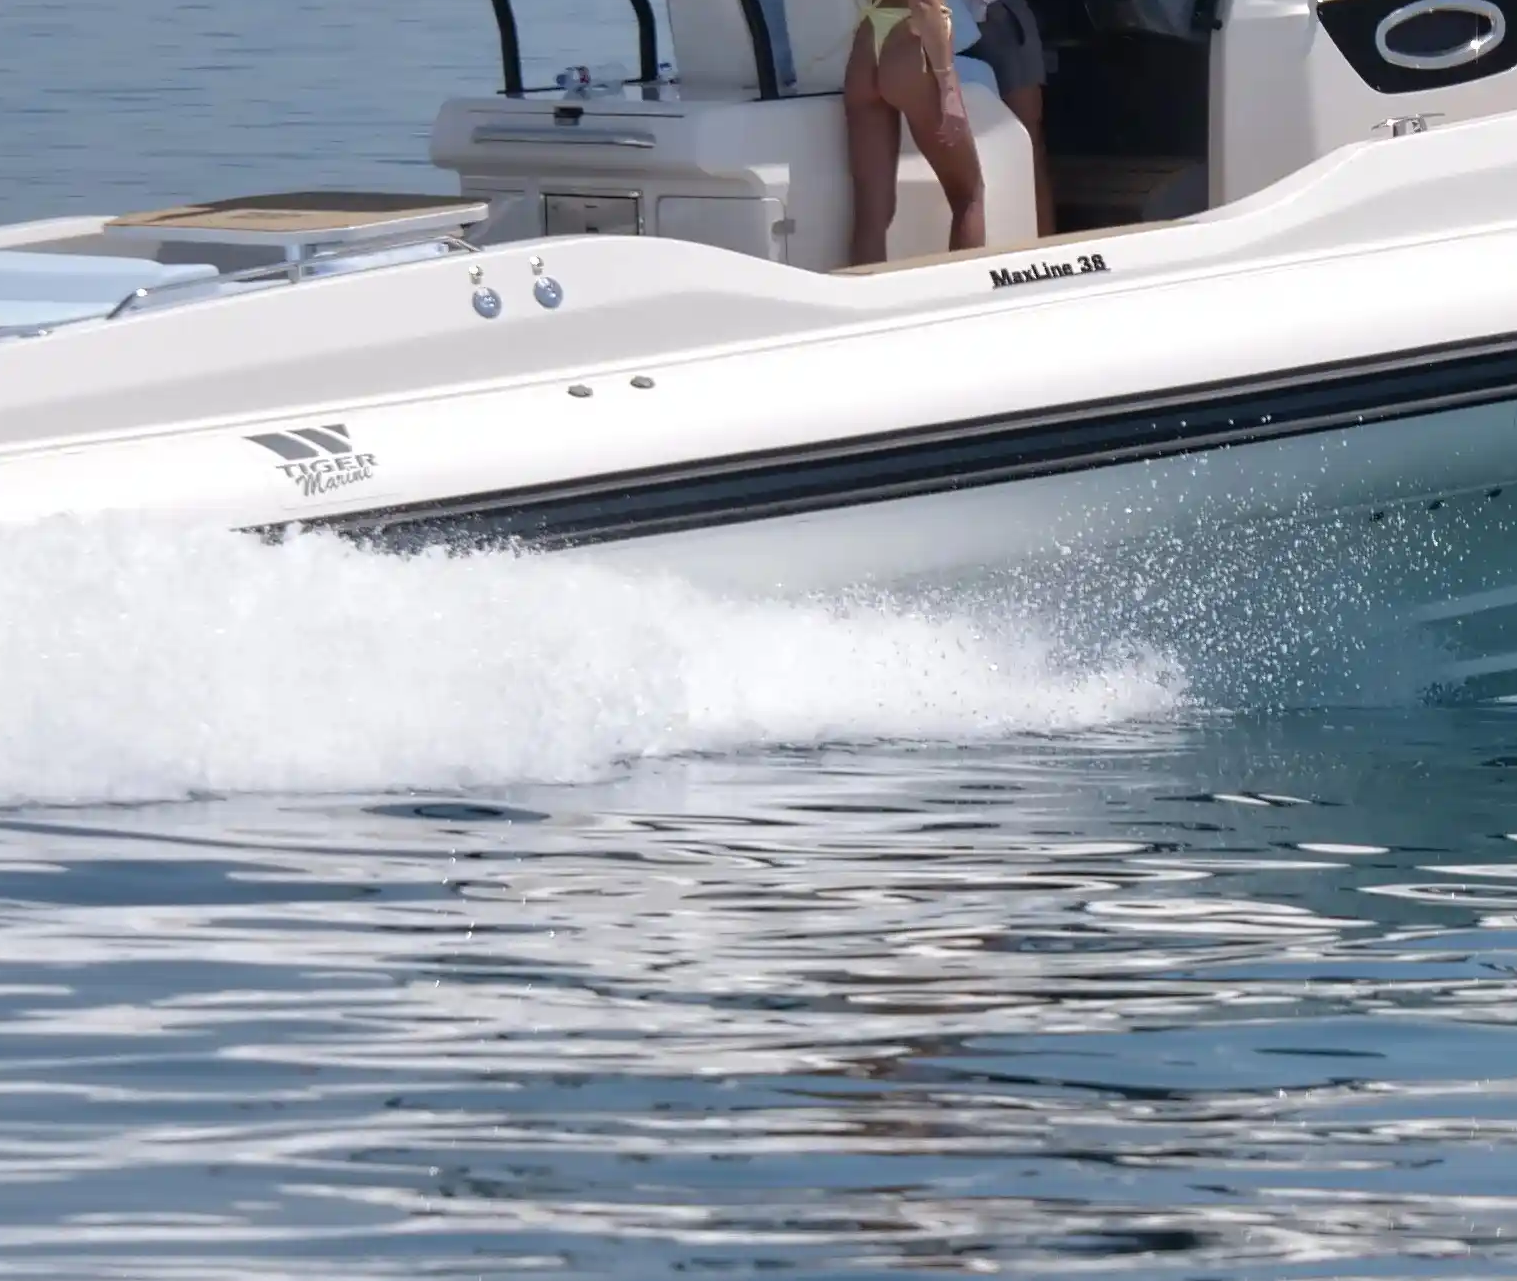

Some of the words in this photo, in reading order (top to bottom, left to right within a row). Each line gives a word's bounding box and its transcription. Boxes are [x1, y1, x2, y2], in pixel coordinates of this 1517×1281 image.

[989, 261, 1074, 290] MaxLine
[1077, 253, 1111, 274] 38
[275, 453, 379, 478] TIGER
[295, 467, 373, 496] Marine
